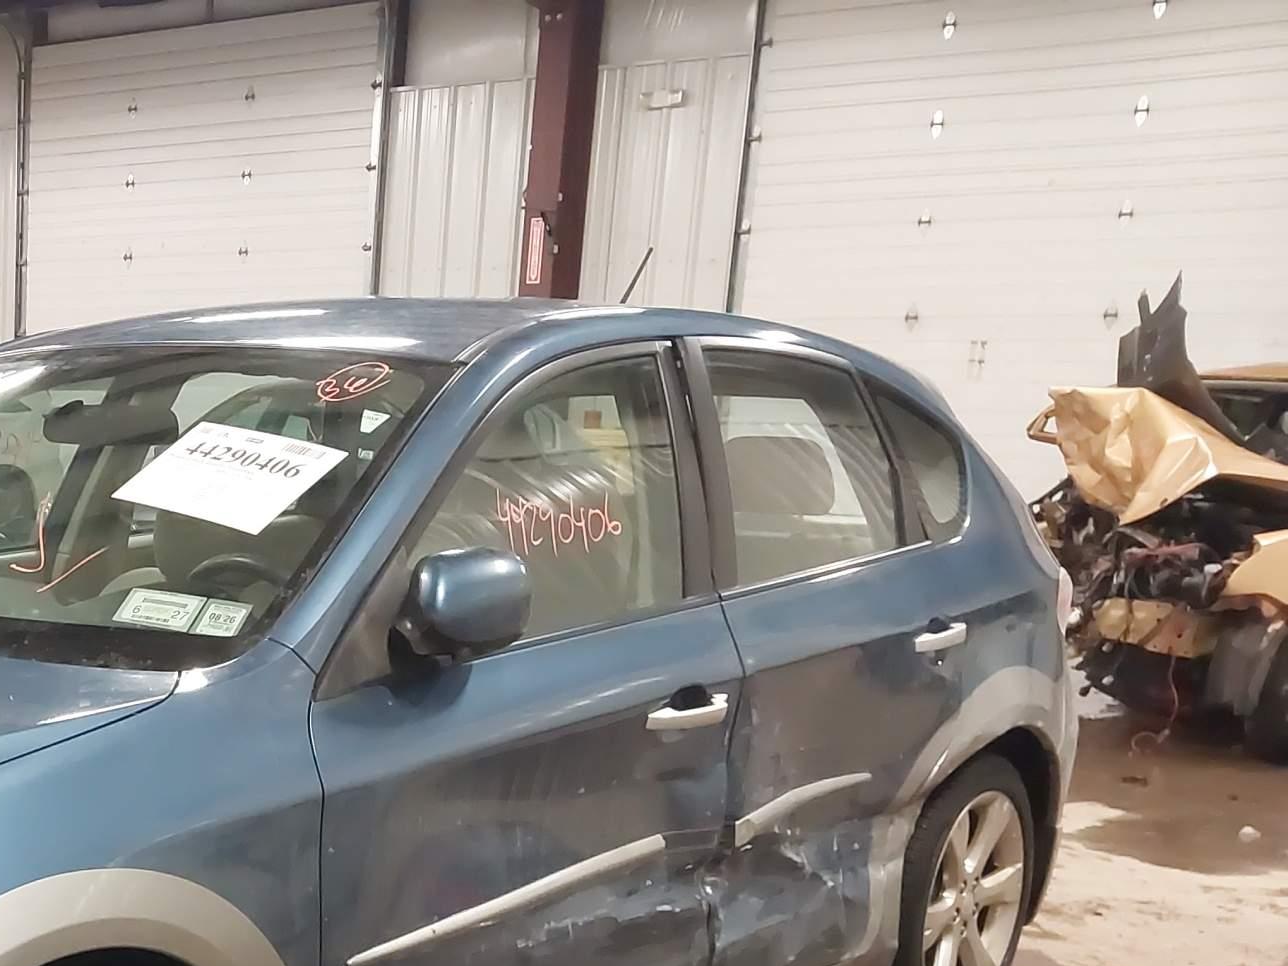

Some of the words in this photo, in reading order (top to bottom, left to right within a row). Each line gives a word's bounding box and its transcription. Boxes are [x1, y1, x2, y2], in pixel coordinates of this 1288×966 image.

[186, 441, 307, 479] 44290406
[132, 605, 142, 614] 6
[171, 610, 190, 621] 27
